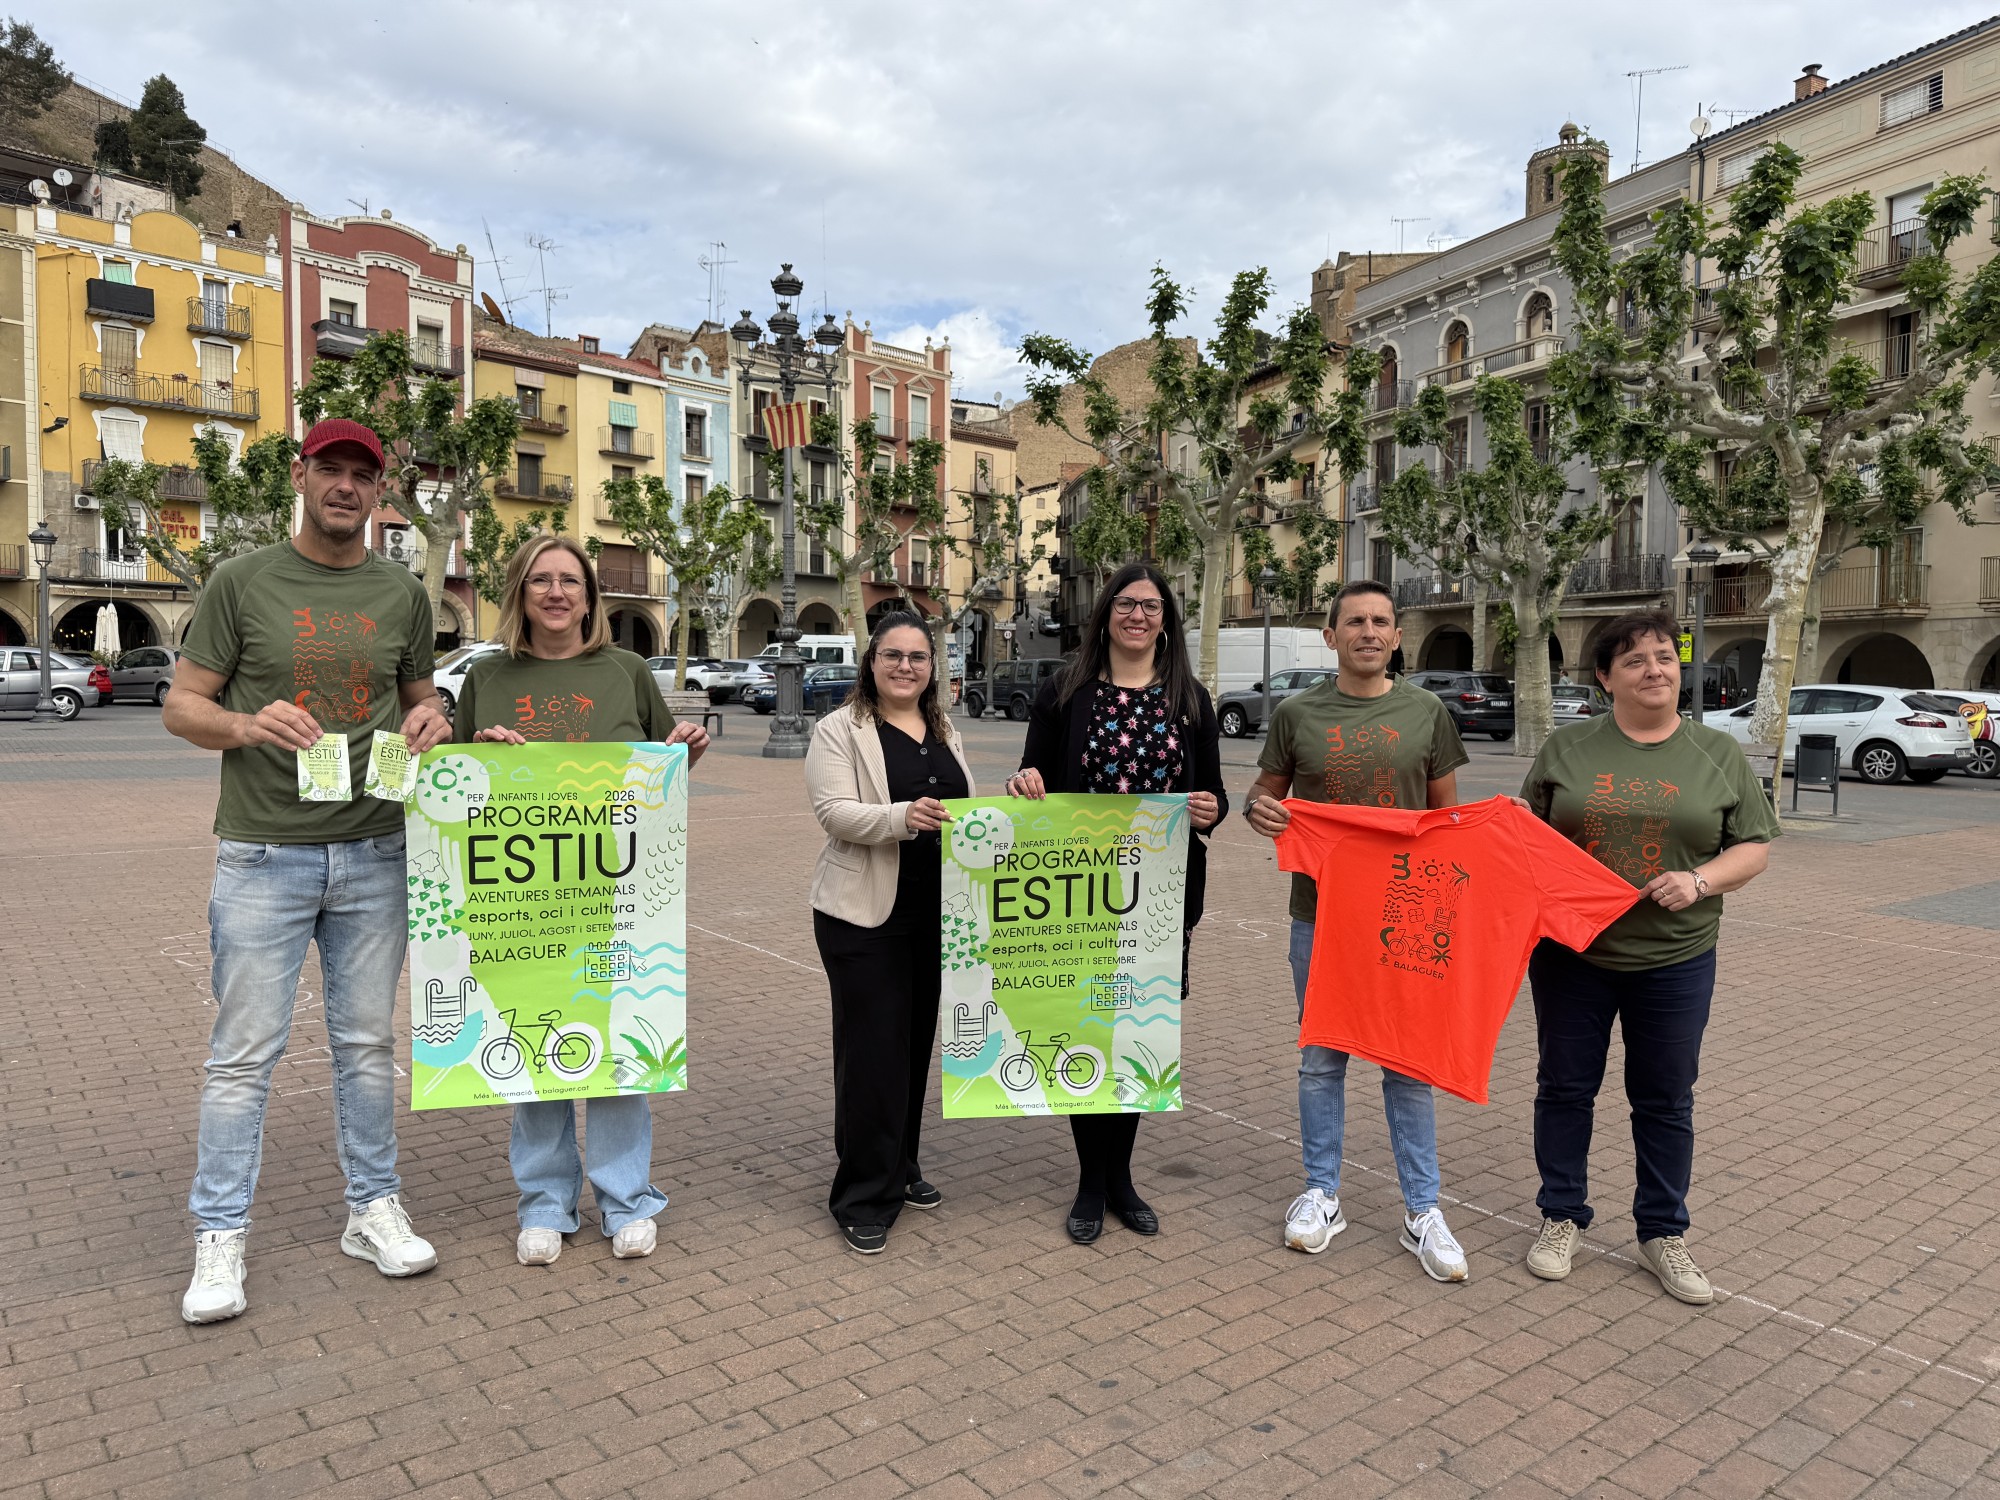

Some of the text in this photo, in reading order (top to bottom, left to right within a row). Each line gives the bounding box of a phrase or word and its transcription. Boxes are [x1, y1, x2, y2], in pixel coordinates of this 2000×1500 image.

[308, 747, 342, 760] ESTIU
[380, 746, 413, 762] ESTIU
[467, 793, 484, 802] PER
[487, 793, 495, 801] A
[498, 792, 538, 801] INFANTS
[547, 792, 578, 801] JOVES
[604, 790, 635, 801] 2026
[467, 804, 637, 828] PROGRAMES
[994, 842, 1009, 851] PER
[1020, 839, 1055, 848] INFANTS
[1062, 836, 1090, 845] JOVES
[1112, 834, 1141, 845] 2026
[468, 831, 637, 885] ESTIU
[994, 847, 1141, 873] PROGRAMES
[468, 883, 636, 903] AVENTURES SETMANALS
[993, 871, 1140, 922] ESTIU
[469, 902, 635, 926] esports, oci i cultura
[468, 931, 497, 941] JUNY,
[539, 925, 576, 936] AGOST
[586, 921, 635, 933] SETEMBRE
[992, 920, 1138, 939] AVENTURES SETMANALS
[469, 943, 567, 964] BALAGUER
[992, 936, 1137, 957] esports, oci i cultura
[991, 961, 1015, 970] JUNY,
[1051, 957, 1084, 967] AGOST
[1092, 955, 1137, 965] SETEMBRE
[1393, 960, 1445, 980] BALAGUER
[991, 974, 1076, 990] BALAGUER
[492, 1090, 533, 1098] informació
[542, 1085, 590, 1095] balaguer.cat
[1010, 1101, 1046, 1109] informació
